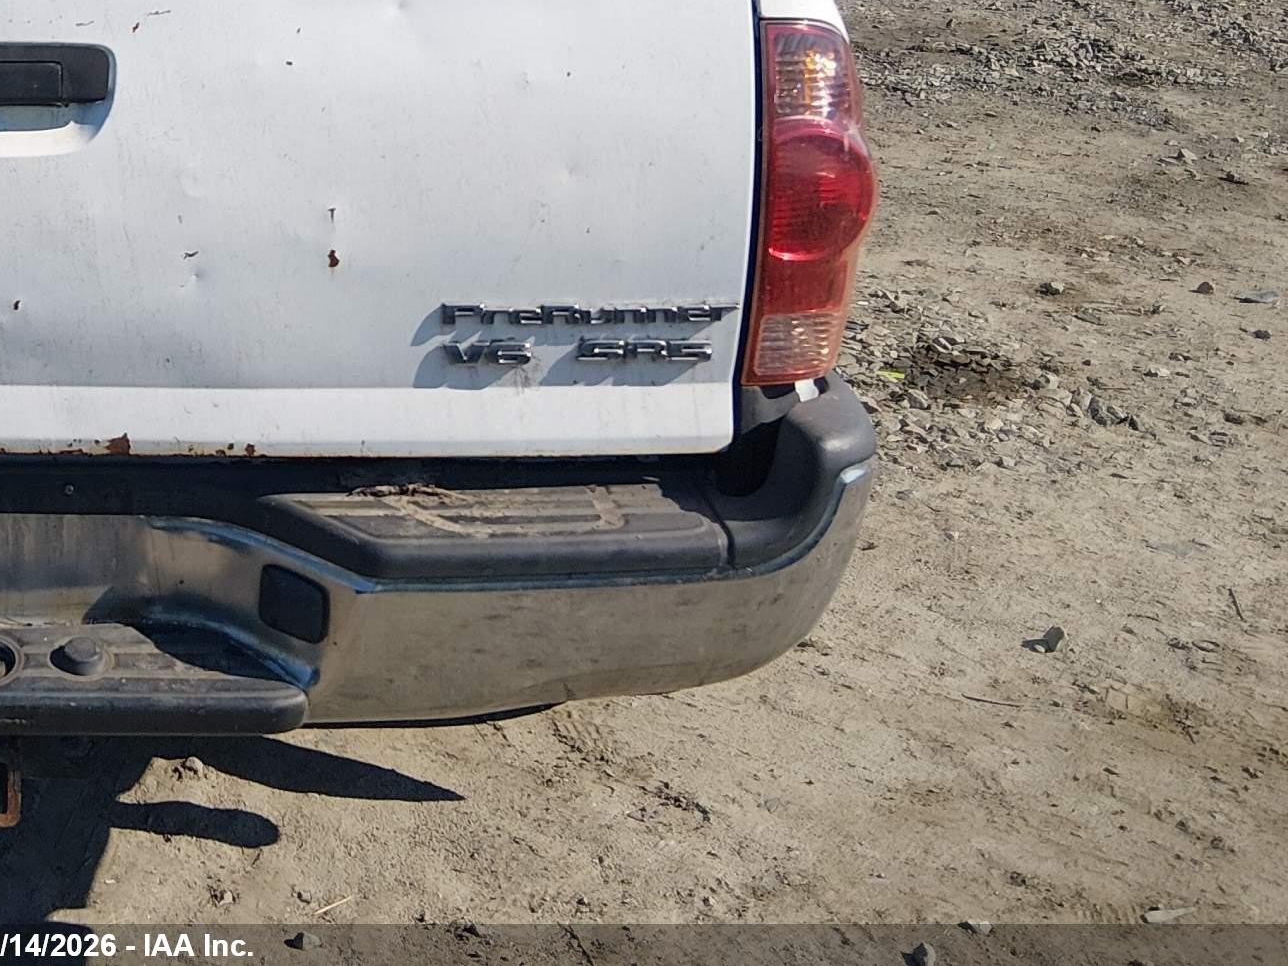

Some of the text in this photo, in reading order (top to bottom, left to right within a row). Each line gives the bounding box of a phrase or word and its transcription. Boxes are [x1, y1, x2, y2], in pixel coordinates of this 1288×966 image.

[443, 302, 739, 324] PreRunner
[444, 337, 712, 365] V6 SR5
